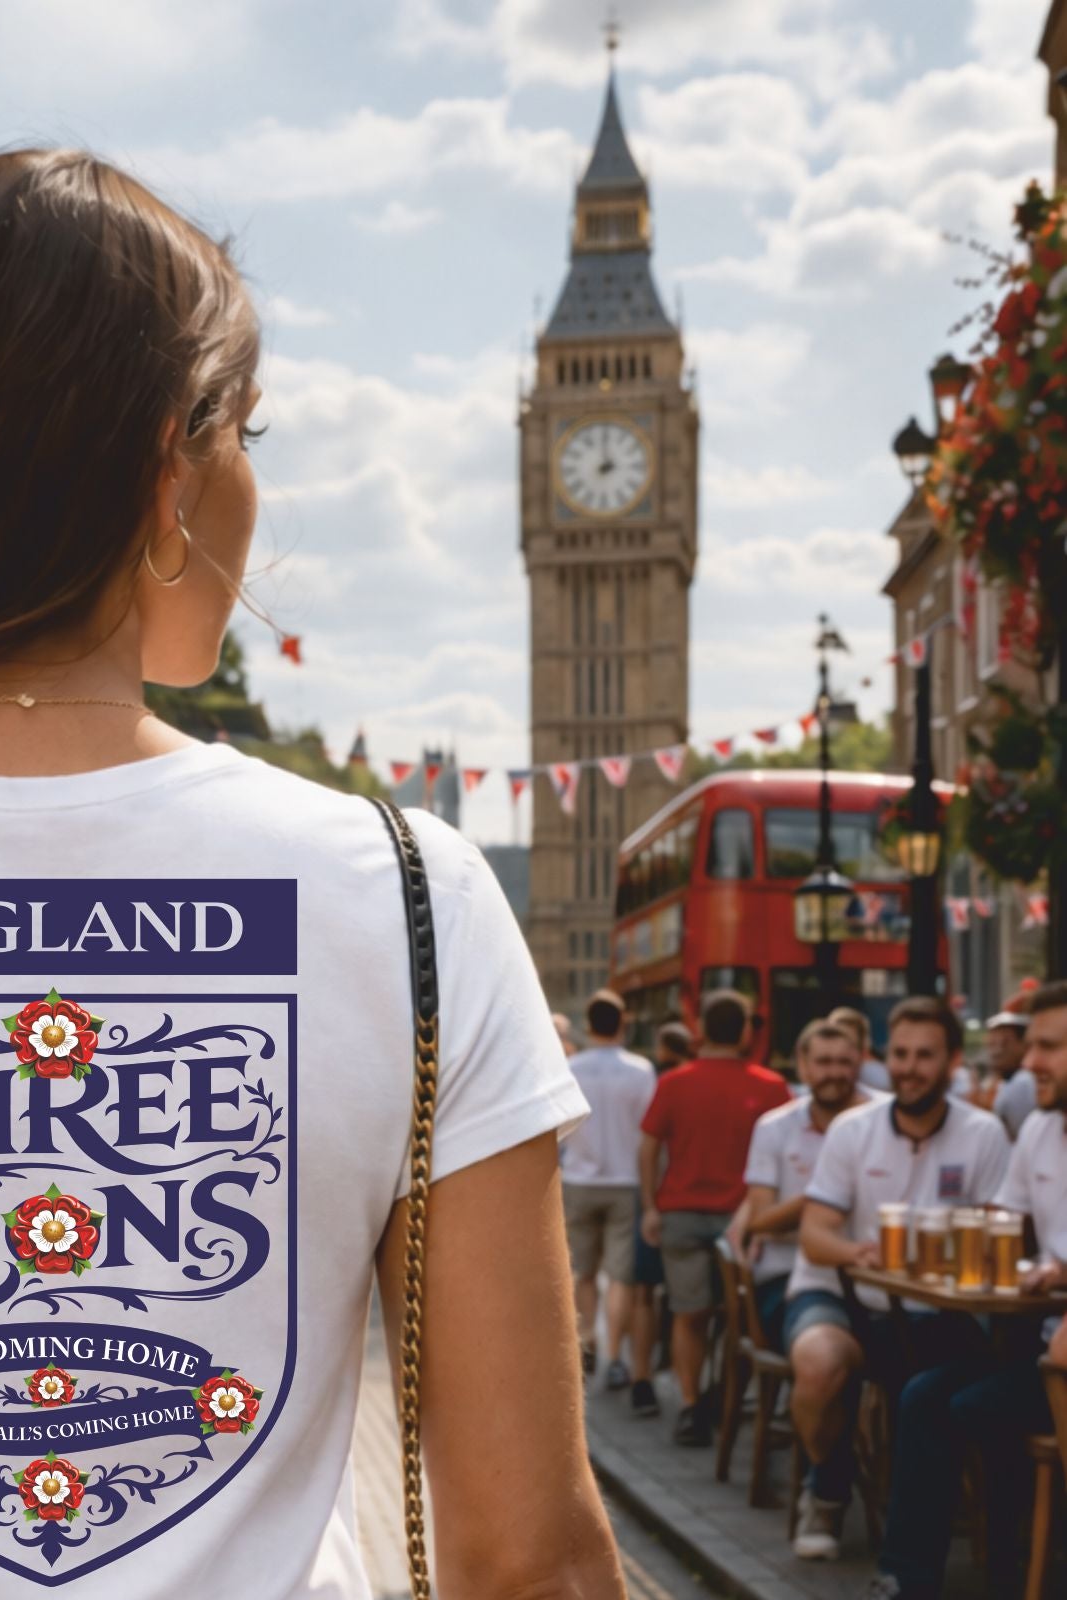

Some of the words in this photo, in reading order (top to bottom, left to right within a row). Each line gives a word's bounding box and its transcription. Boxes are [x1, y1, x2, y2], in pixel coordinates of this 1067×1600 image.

[102, 1337, 200, 1378] HOME
[46, 1413, 129, 1440] COMING
[133, 1405, 195, 1427] HOME
